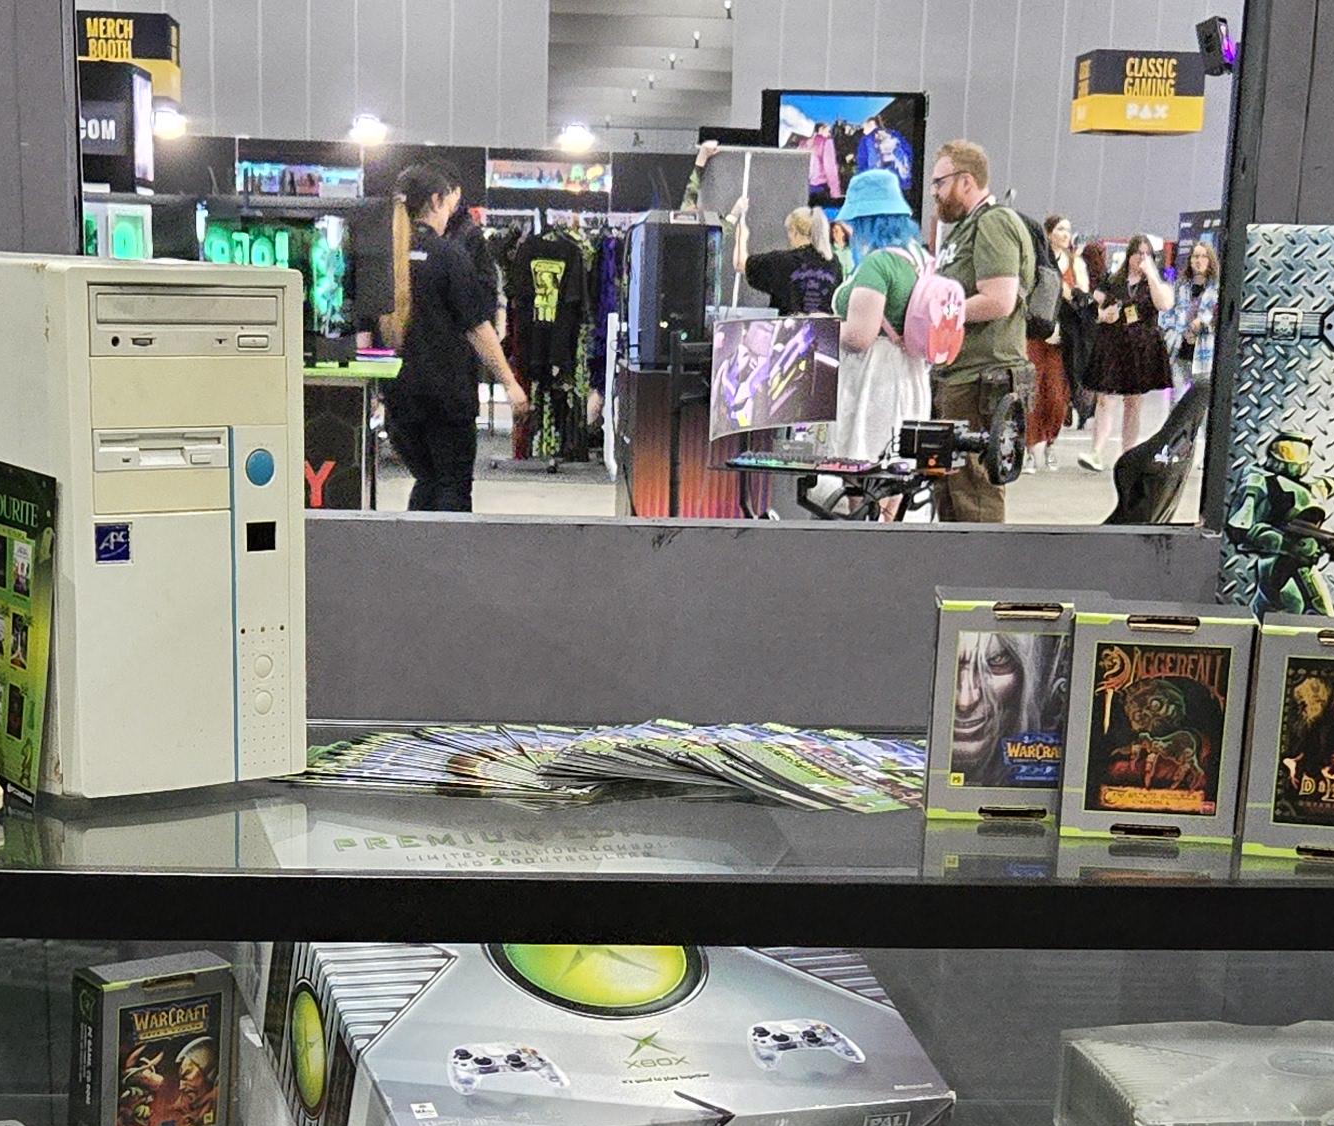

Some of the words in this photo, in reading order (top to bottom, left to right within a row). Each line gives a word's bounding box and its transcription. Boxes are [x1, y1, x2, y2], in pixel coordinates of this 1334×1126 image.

[86, 17, 134, 39] MERCH
[88, 39, 133, 59] BOOTH
[1125, 57, 1177, 78] CLASSIC
[1123, 77, 1175, 97] GAMING
[1095, 646, 1227, 698] DAGGERFALL
[333, 830, 542, 852] PREMIUM
[489, 857, 506, 866] 2
[131, 1003, 210, 1032] WARCRAFT
[623, 1056, 690, 1069] XBOX
